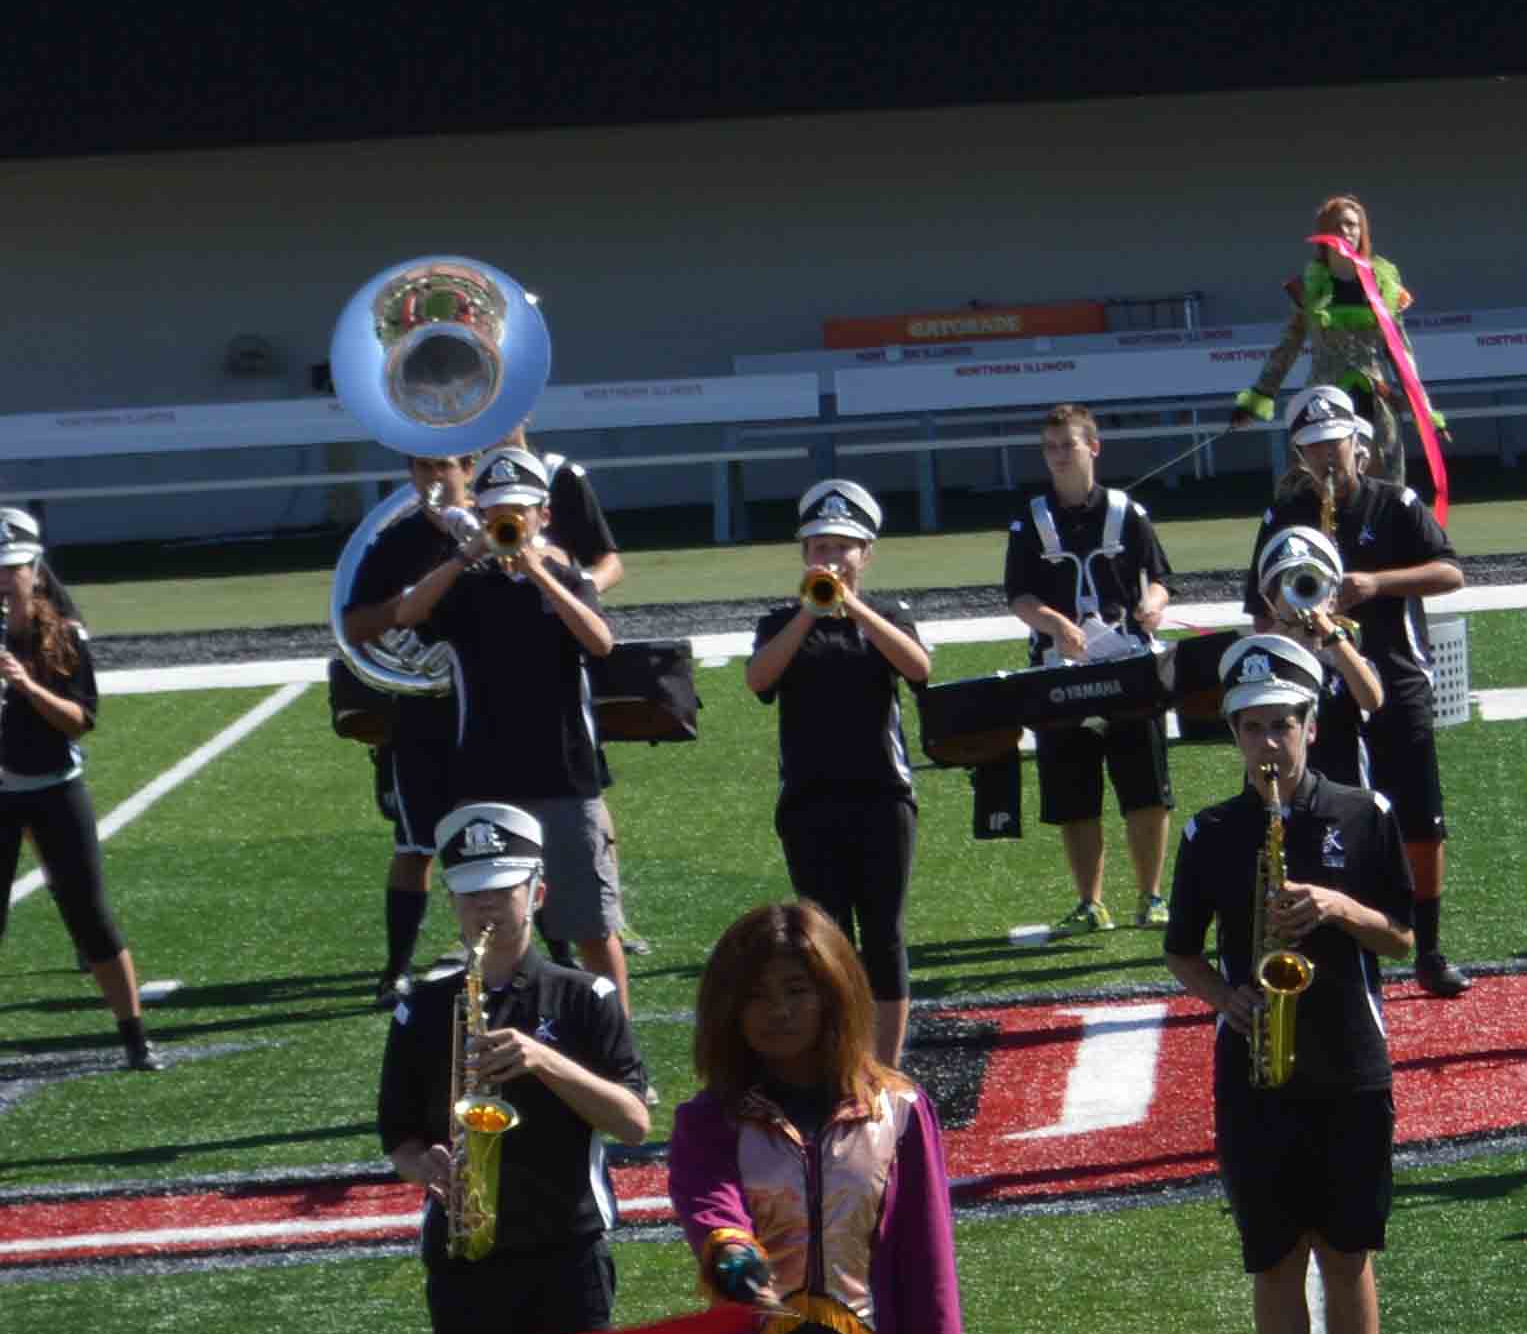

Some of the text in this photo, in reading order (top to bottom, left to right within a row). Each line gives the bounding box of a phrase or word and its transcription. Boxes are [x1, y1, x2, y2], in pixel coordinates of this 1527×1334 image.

[907, 314, 1021, 338] GATORADE
[955, 363, 1021, 377] NORTHERN
[1065, 679, 1122, 701] YAMAHA
